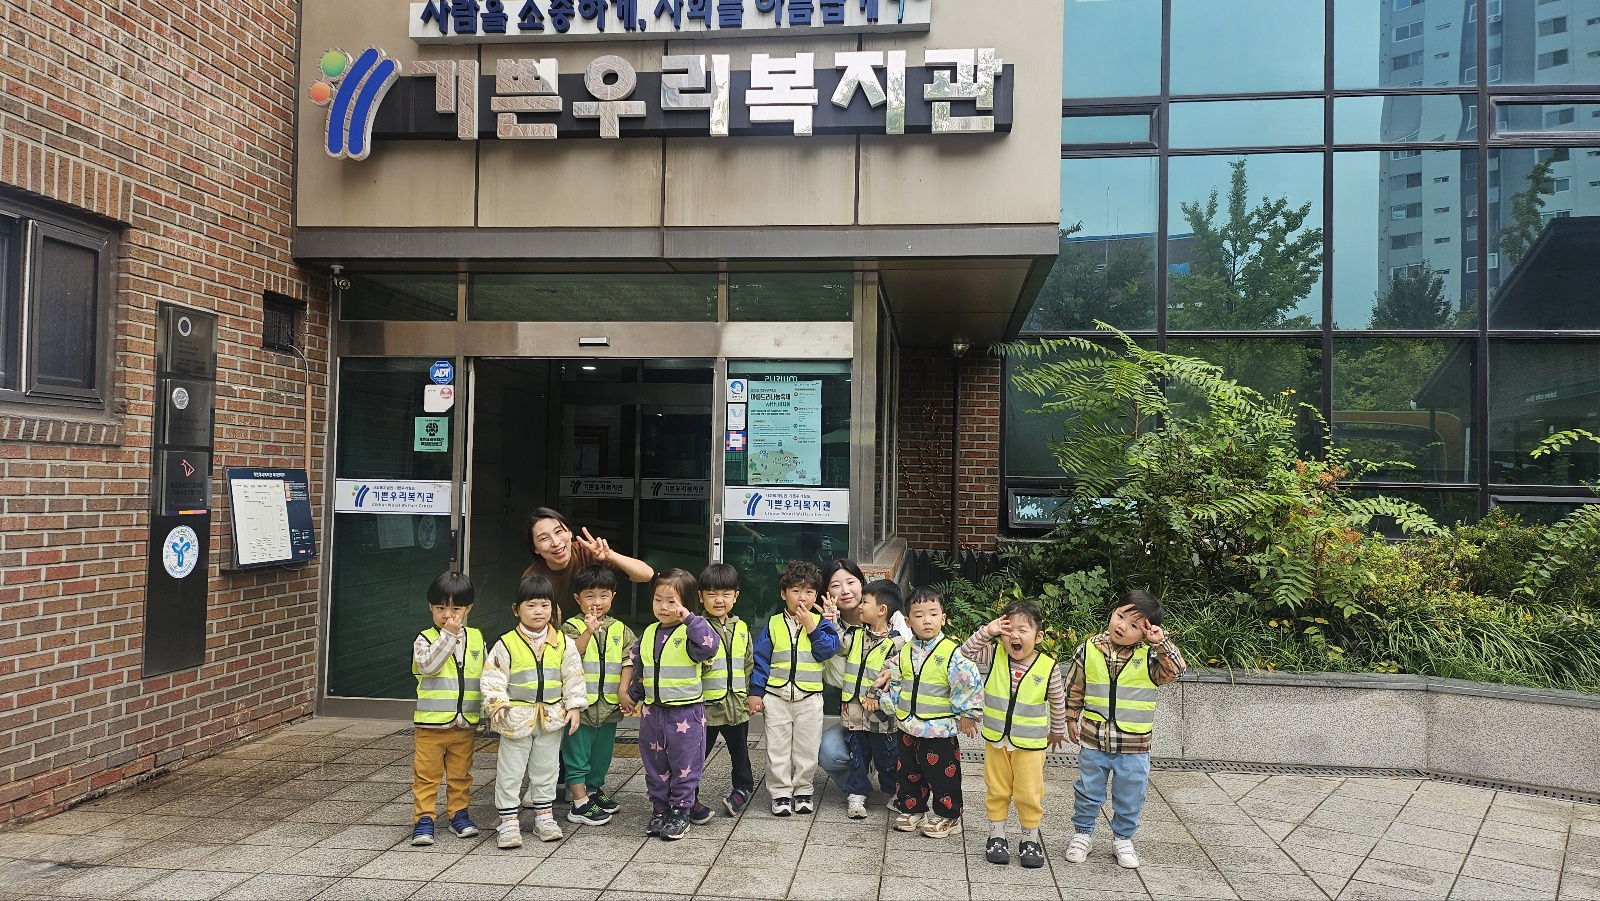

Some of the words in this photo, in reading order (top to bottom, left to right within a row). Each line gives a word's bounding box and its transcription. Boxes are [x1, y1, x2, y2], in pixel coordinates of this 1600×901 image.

[420, 0, 508, 34] 사람을
[410, 47, 1003, 140] 기쁜우리복지관
[434, 368, 450, 377] ADT
[372, 491, 434, 503] 기쁜우리복지관
[765, 499, 831, 511] 기쁜우리복지관
